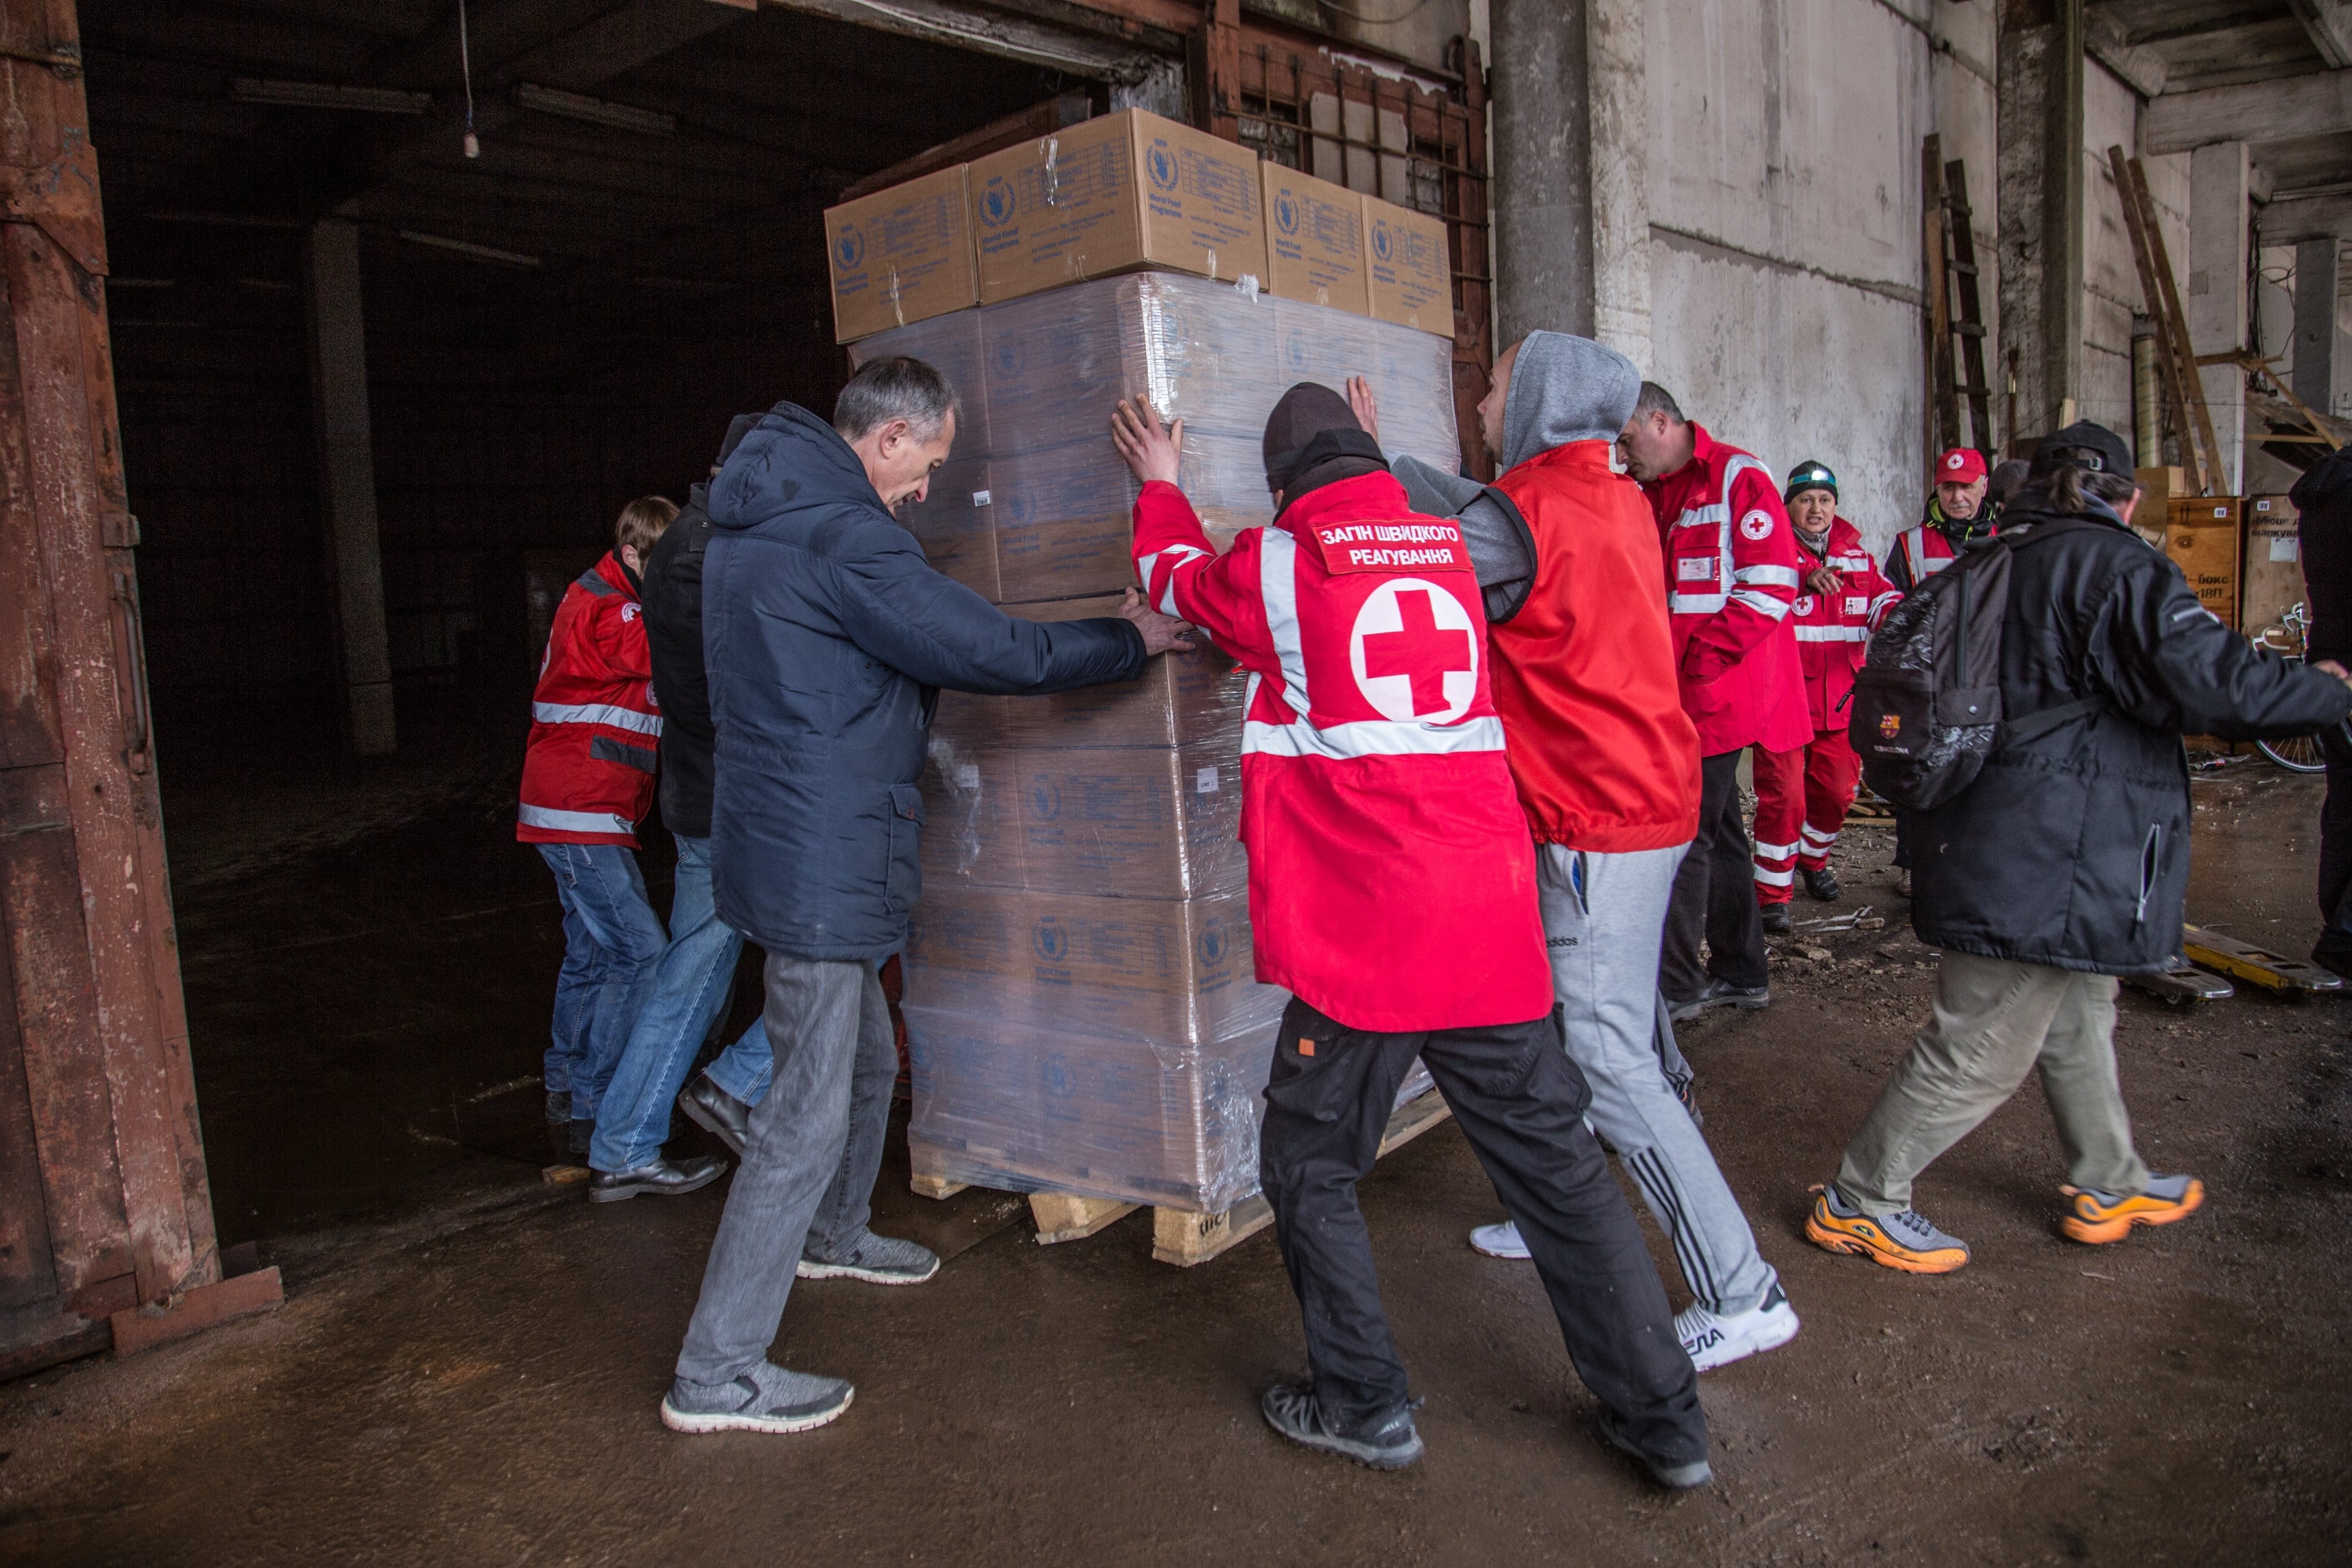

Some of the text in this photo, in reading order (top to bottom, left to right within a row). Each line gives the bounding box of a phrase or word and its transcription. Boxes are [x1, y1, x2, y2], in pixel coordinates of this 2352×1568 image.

[1154, 138, 1167, 148] WFP
[987, 176, 1003, 187] WFP
[1149, 193, 1181, 208] World Food
[1150, 204, 1182, 218] Programme
[982, 231, 1001, 245] World
[1003, 227, 1019, 238] Food
[1276, 238, 1290, 248] World
[983, 239, 1019, 254] Programme
[1276, 248, 1302, 260] Programme
[837, 276, 853, 287] World
[838, 282, 869, 296] Programme
[1321, 525, 1459, 544] ЗАГІН ШВИДКОГО
[1349, 549, 1454, 565] РЕАГУВАННЯ
[2198, 574, 2229, 584] бокс
